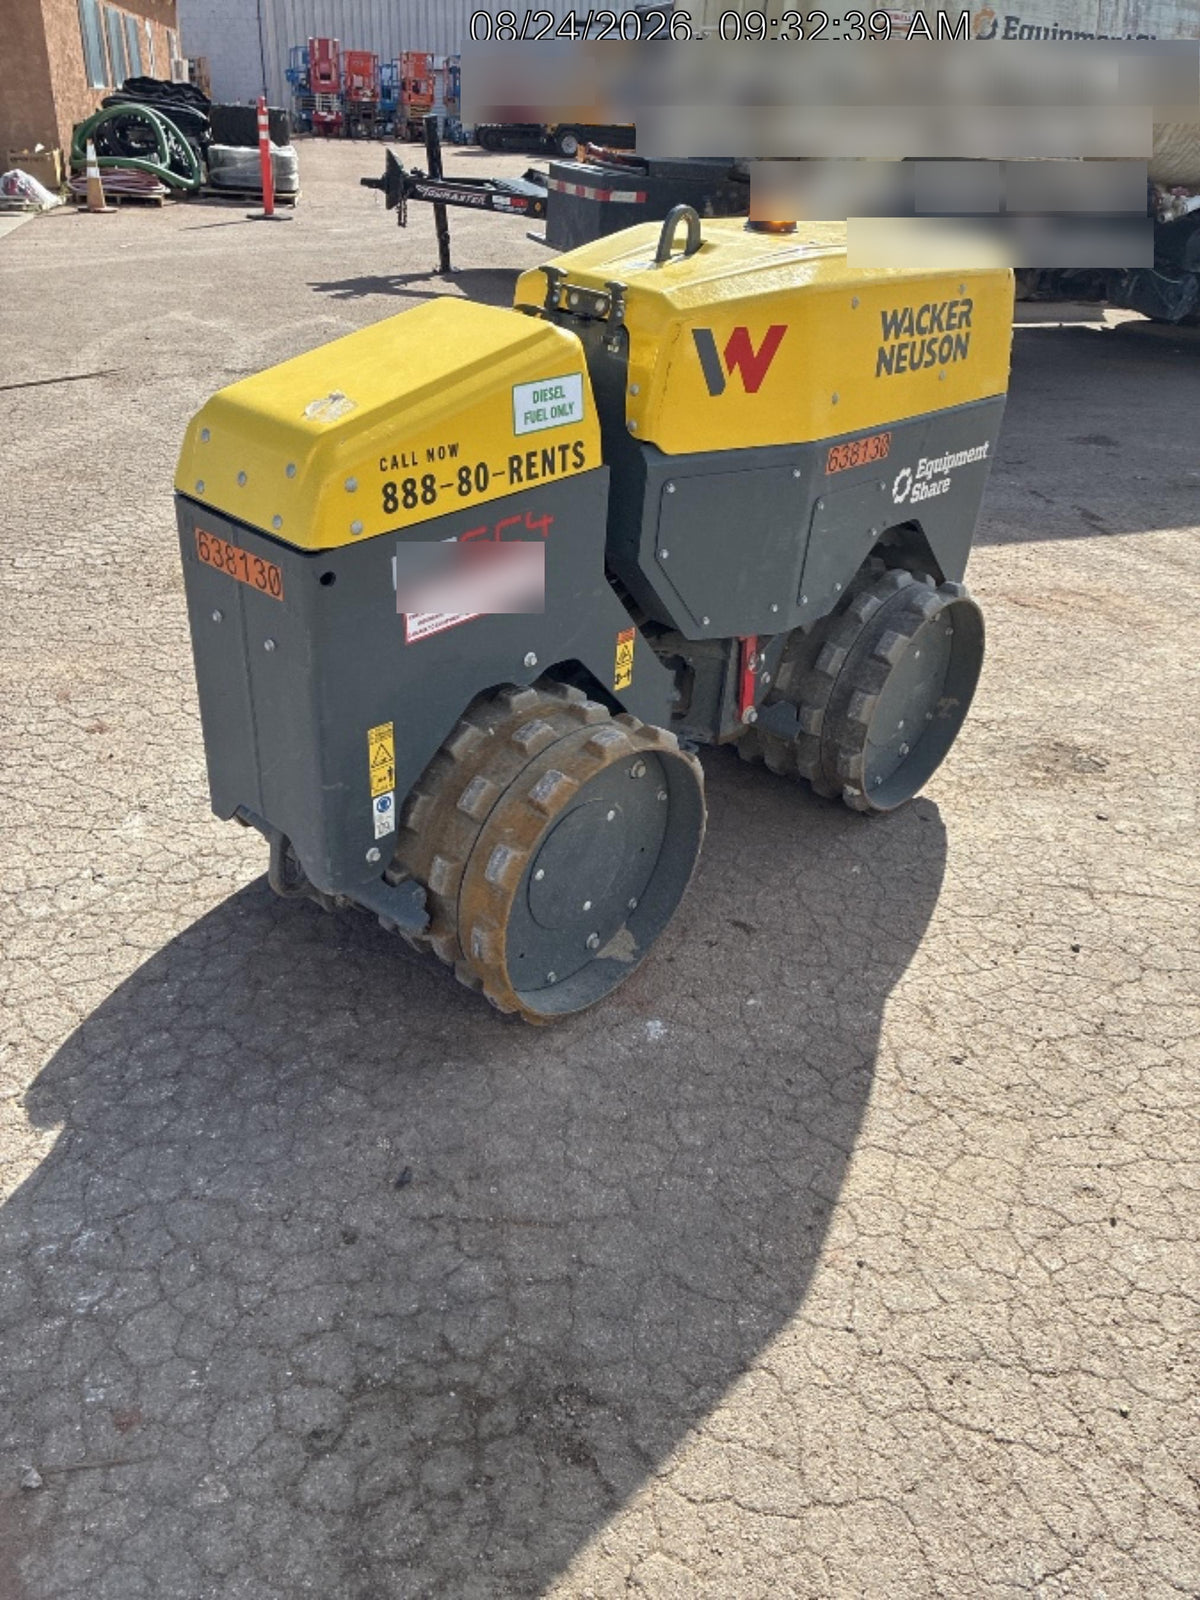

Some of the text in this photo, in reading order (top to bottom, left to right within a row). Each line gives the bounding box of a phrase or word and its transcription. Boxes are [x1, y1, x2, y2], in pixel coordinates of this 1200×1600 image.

[881, 299, 973, 342] WACKER
[875, 332, 970, 377] NEUSON
[523, 401, 575, 426] FUEL ONLY
[532, 385, 566, 404] DIESEL
[379, 443, 460, 472] CALL NOW
[828, 433, 889, 472] 638130
[915, 440, 990, 481] Equipment
[381, 440, 586, 515] 888-80-RENTS
[910, 477, 951, 504] Share
[198, 531, 281, 597] 638130
